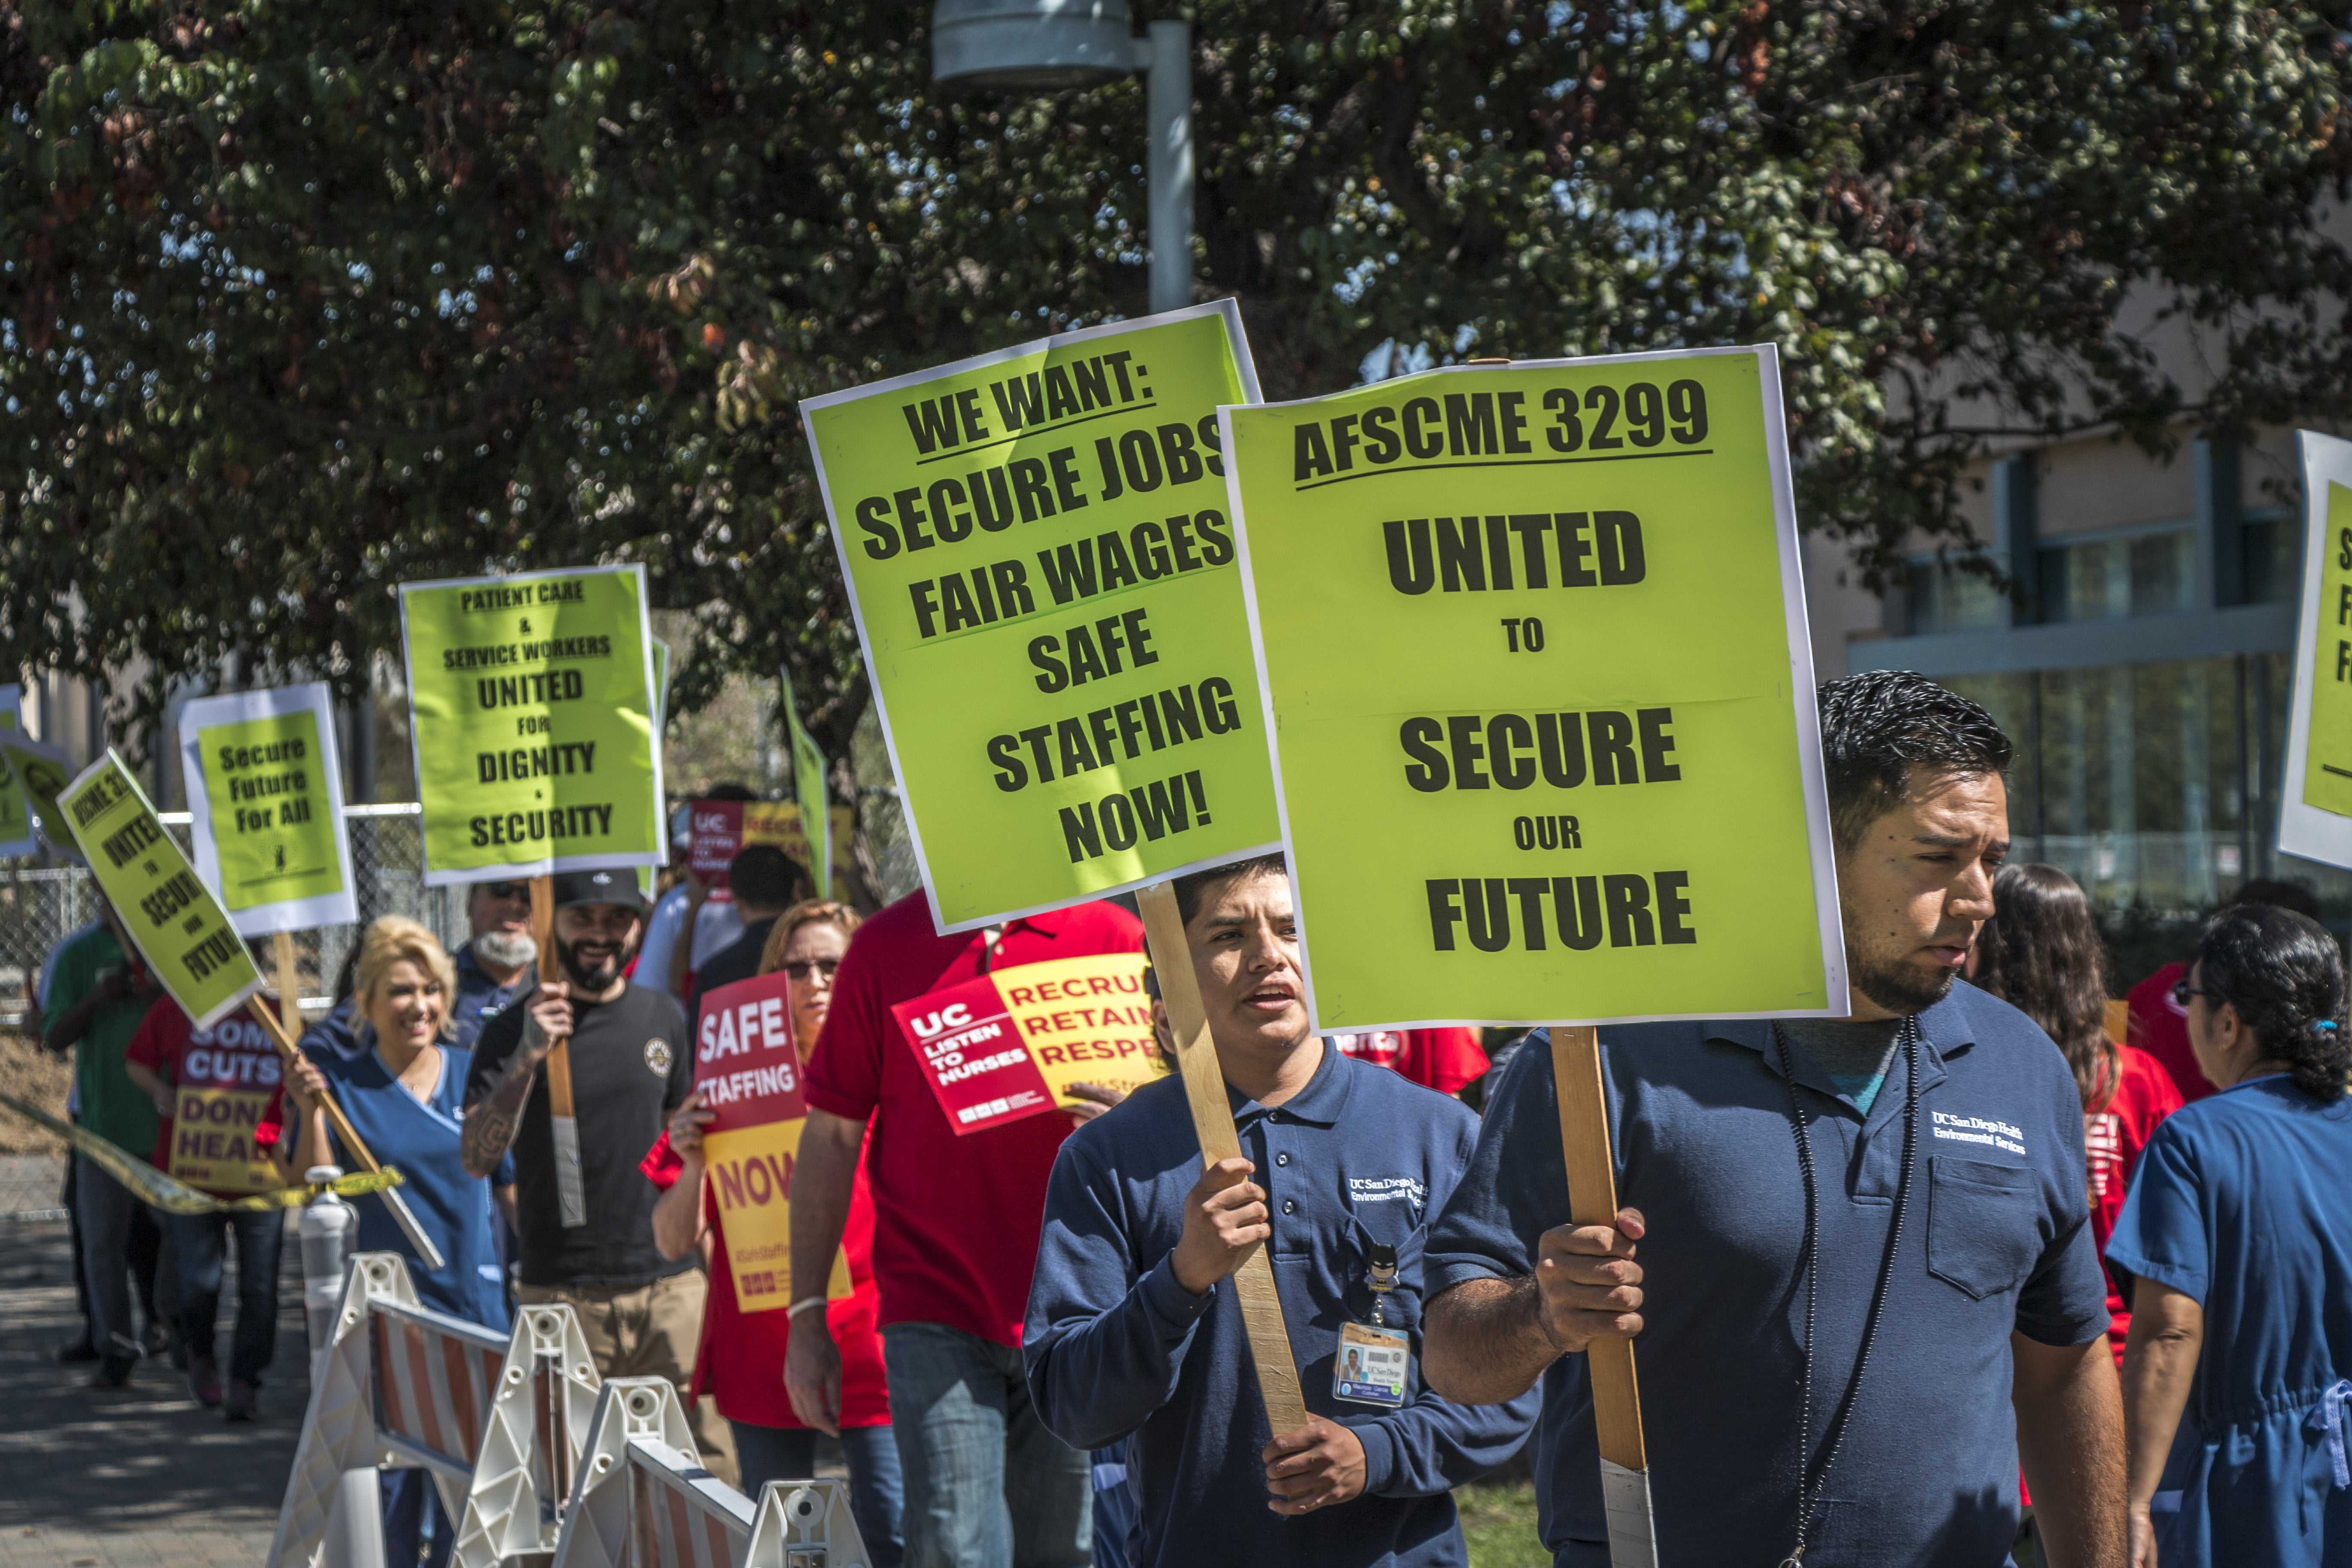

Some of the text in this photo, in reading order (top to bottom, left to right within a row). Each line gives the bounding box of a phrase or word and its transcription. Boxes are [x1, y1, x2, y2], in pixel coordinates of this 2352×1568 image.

[902, 350, 1155, 455] WE WANT:
[1294, 379, 1709, 481] AFSCME 3299
[855, 413, 1226, 560] SECURE JOBS
[1382, 510, 1646, 595] UNITED
[909, 509, 1234, 639] FAIR WAGES
[461, 580, 584, 611] PATIENT CARE
[519, 617, 532, 634] &
[1501, 617, 1545, 653] TO
[443, 635, 611, 668] SERVICE WORKERS
[1027, 607, 1159, 694] SAFE
[478, 669, 583, 709] UNITED
[518, 715, 551, 736] FOR
[986, 677, 1242, 793] STAFFING
[219, 737, 306, 771] Secure
[477, 741, 595, 784] DIGNITY
[1399, 707, 1681, 793] SECURE
[229, 770, 307, 802] Future
[235, 798, 311, 833] For All
[469, 802, 612, 846] SECURITY
[1058, 769, 1212, 864] NOW!
[1513, 815, 1582, 851] OUR
[140, 868, 202, 928] SECUR
[1425, 870, 1697, 952] FUTURE
[181, 925, 242, 983] FUTUR
[1008, 974, 1144, 1007] RECRU
[698, 996, 787, 1063] SAFE
[910, 1003, 973, 1038] UC
[923, 1023, 1002, 1059] LISTEN
[1039, 1037, 1160, 1066] RESPE
[185, 1048, 282, 1085] CUTS
[929, 1051, 964, 1072] TO
[937, 1048, 1028, 1087] NURSES
[696, 1063, 796, 1108] STAFFING
[1932, 1111, 2024, 1140] UC San Diego Health
[1932, 1126, 2026, 1155] Environmental Services
[1349, 1178, 1364, 1189] UC
[1364, 1178, 1384, 1189] San
[1383, 1178, 1410, 1189] Diego
[1351, 1188, 1406, 1202] Environmental
